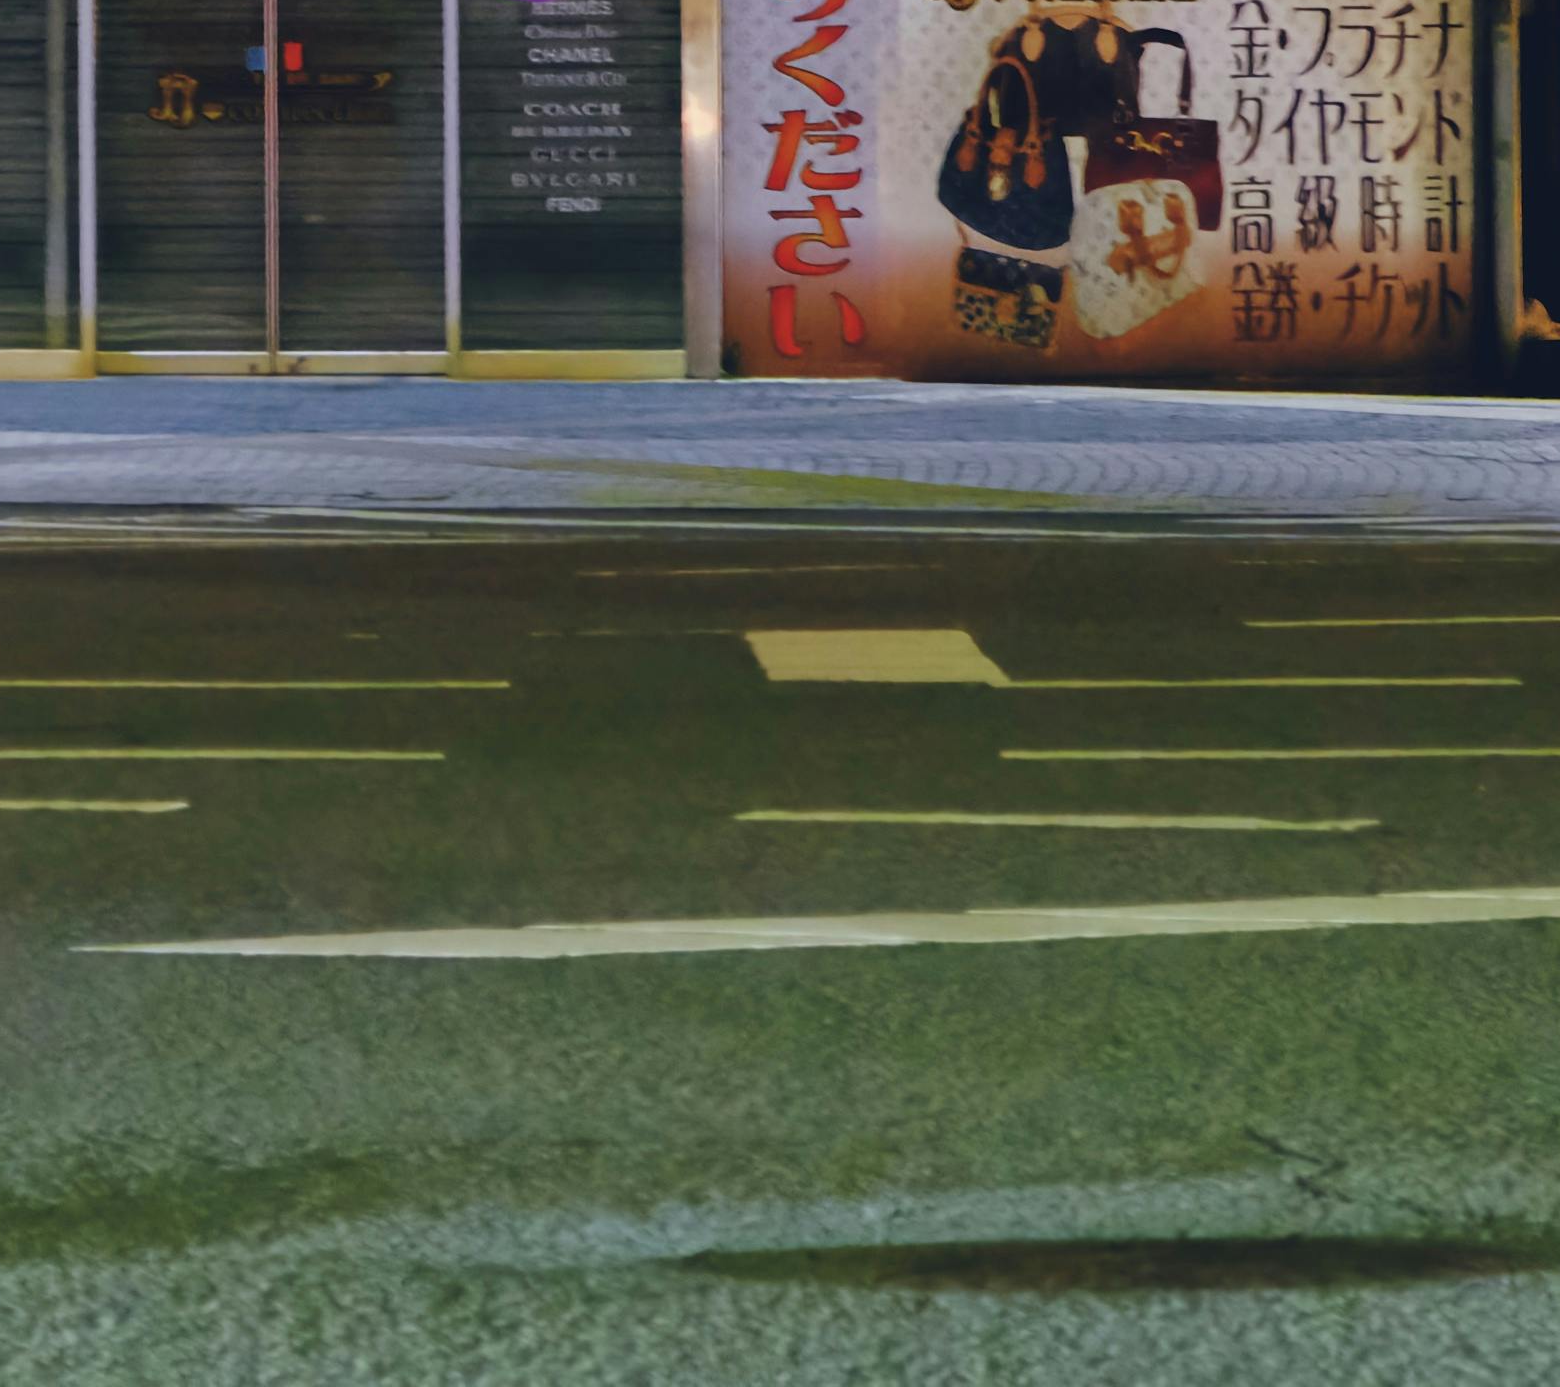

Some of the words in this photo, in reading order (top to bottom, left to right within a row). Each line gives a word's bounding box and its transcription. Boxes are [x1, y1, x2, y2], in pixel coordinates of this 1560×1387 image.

[1230, 87, 1464, 166] ダイヤモンド
[1230, 175, 1464, 255] 高級時計
